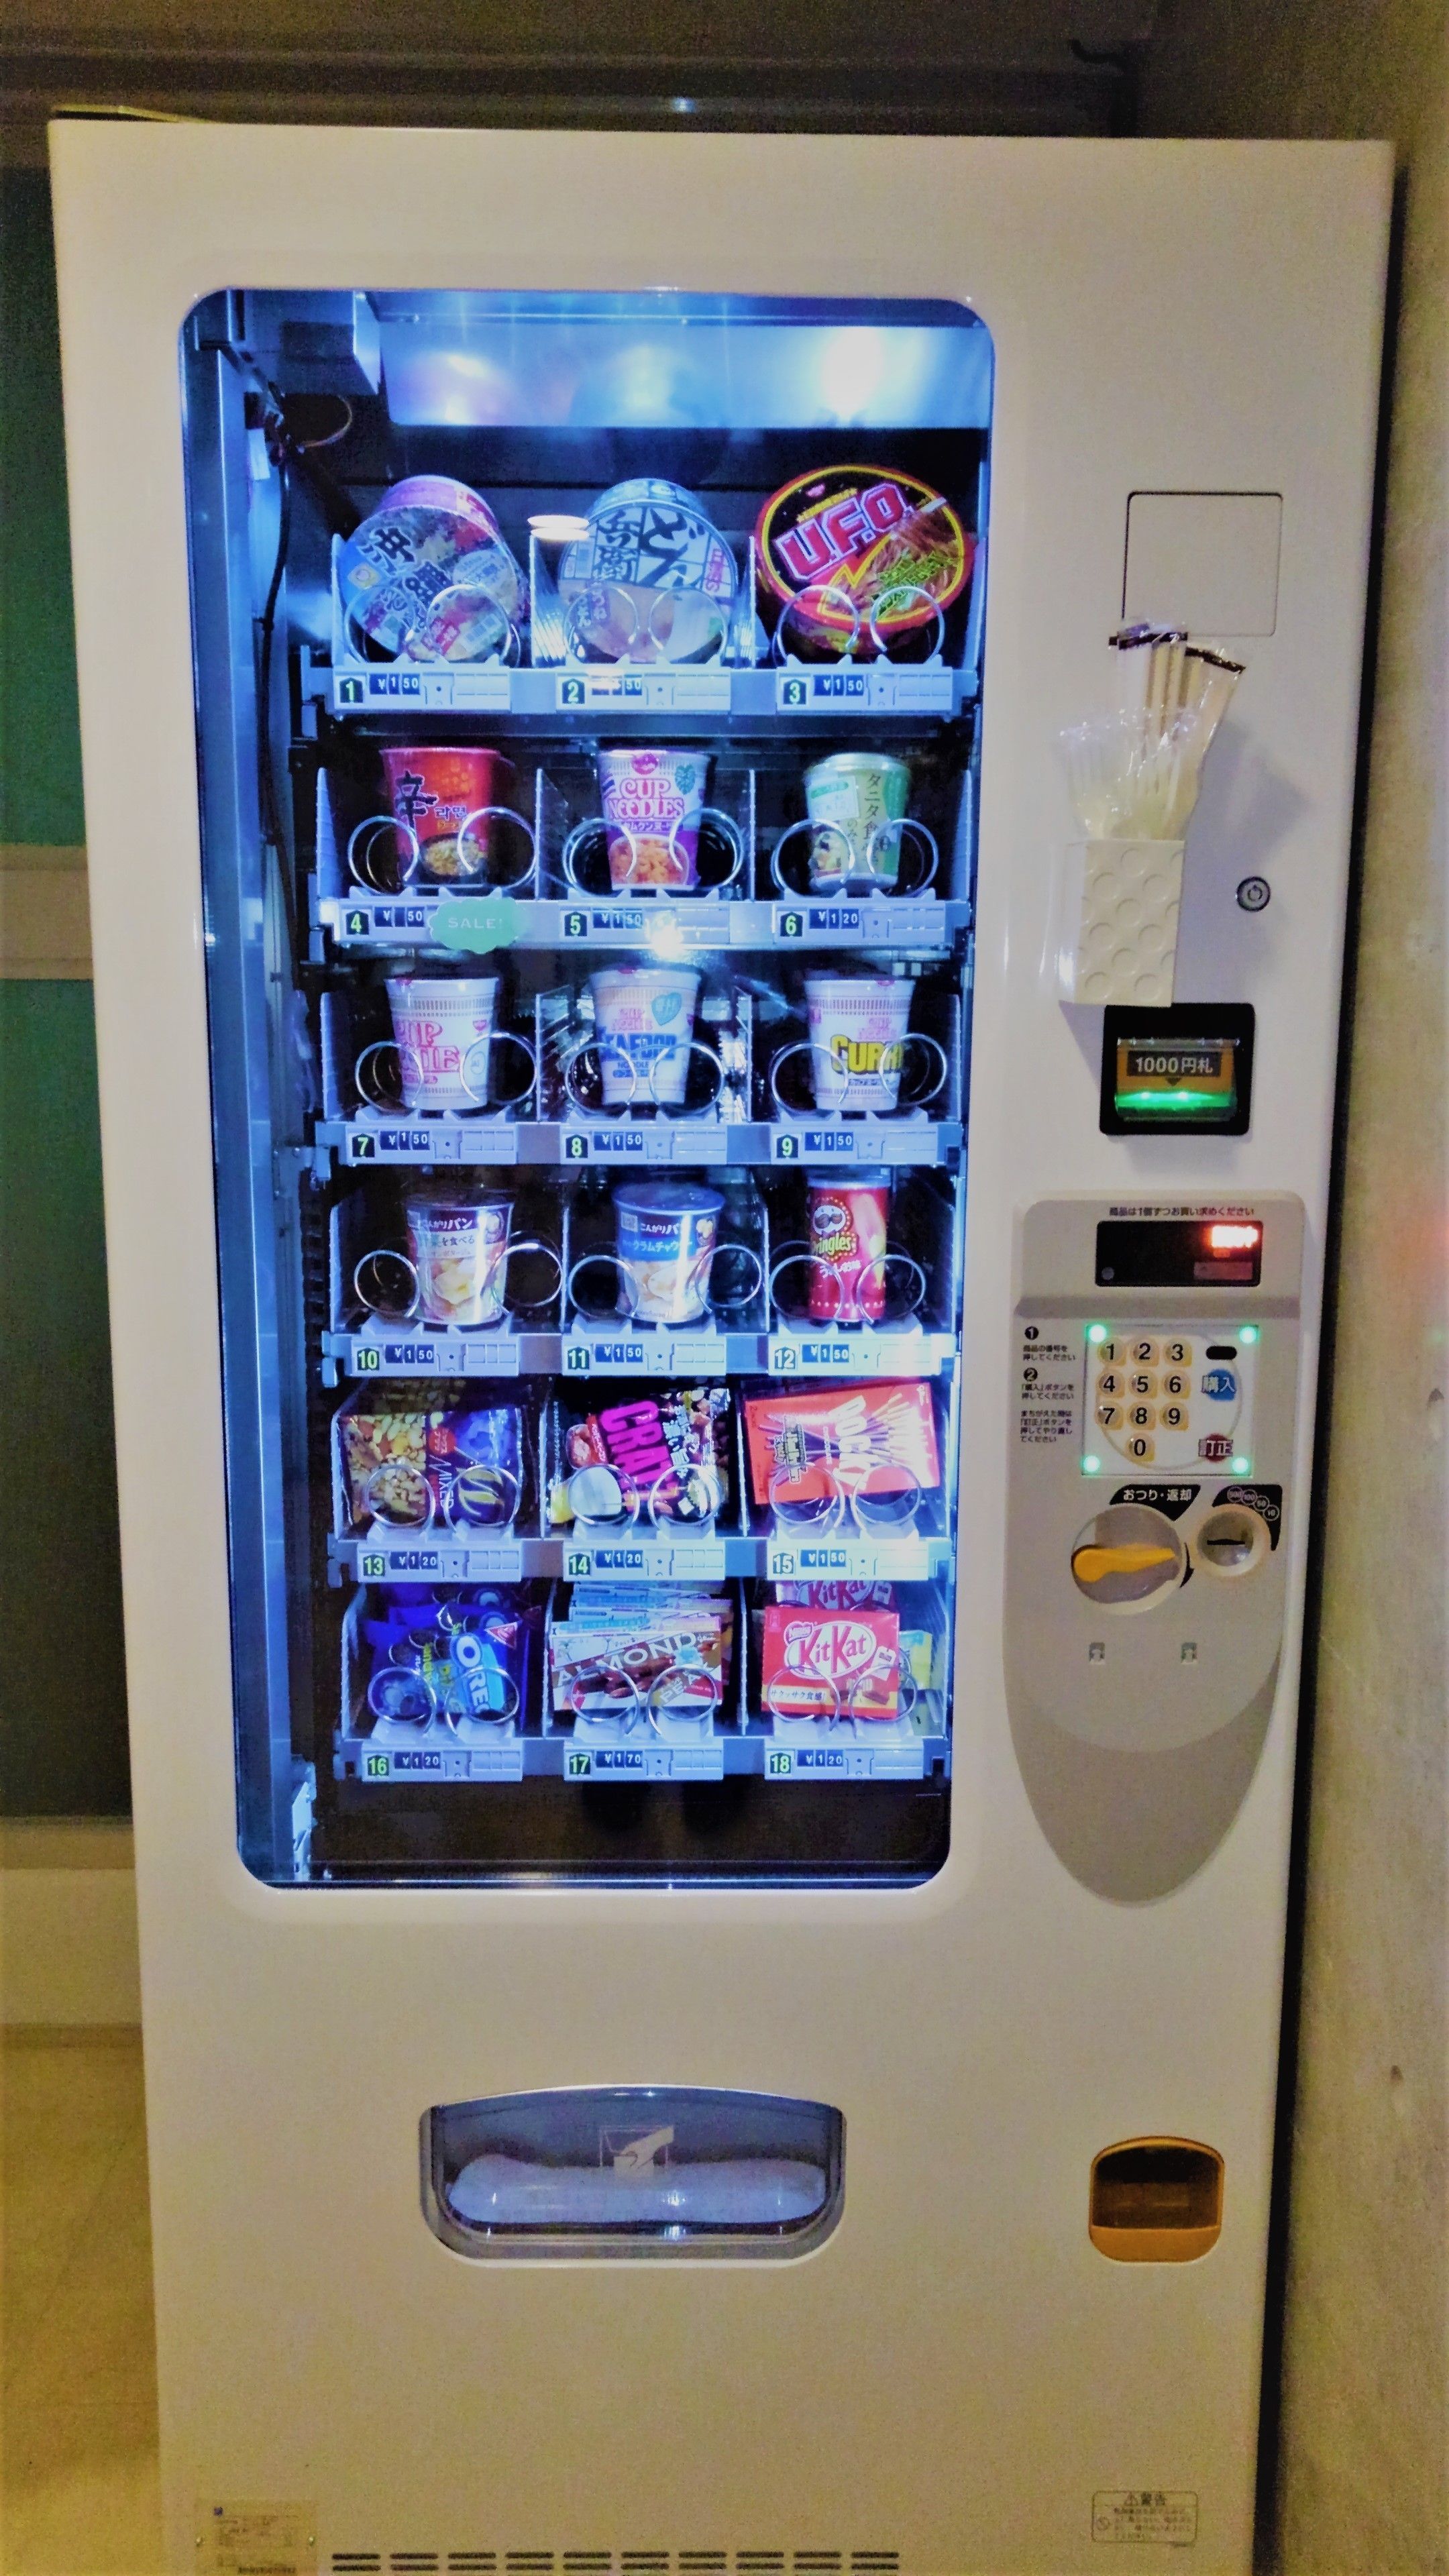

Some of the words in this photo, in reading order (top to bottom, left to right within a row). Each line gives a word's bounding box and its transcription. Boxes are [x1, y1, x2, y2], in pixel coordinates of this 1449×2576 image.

[346, 682, 354, 699] 1
[377, 678, 419, 690] ¥150
[568, 682, 579, 702] 2
[788, 682, 801, 704] 3
[824, 677, 863, 692] ¥150
[620, 778, 671, 800] CUP
[396, 771, 439, 832] 辛
[607, 798, 685, 820] NOODLES
[351, 913, 362, 933] 4
[448, 917, 502, 929] SALE!
[571, 915, 581, 934] 5
[602, 913, 642, 924] ¥150
[786, 915, 796, 934] 6
[818, 912, 858, 924] ¥120
[1136, 1057, 1213, 1073] 1000円札
[358, 1136, 368, 1155] 7
[388, 1132, 428, 1144] ¥150
[572, 1137, 582, 1156] 8
[602, 1134, 642, 1146] ¥150
[782, 1136, 792, 1155] 9
[814, 1134, 853, 1146] ¥150
[359, 1350, 378, 1369] 10
[394, 1348, 433, 1360] ¥150
[569, 1350, 586, 1368] 11
[604, 1346, 642, 1358] ¥150
[774, 1350, 795, 1369] 12
[810, 1346, 849, 1359] ¥150
[1107, 1344, 1114, 1360] 1
[1138, 1342, 1150, 1360] 2
[1171, 1344, 1183, 1361] 3
[1104, 1375, 1116, 1392] 4
[1137, 1376, 1148, 1393] 5
[1169, 1376, 1181, 1393] 6
[1103, 1408, 1115, 1424] 7
[1135, 1407, 1148, 1424] 8
[1168, 1408, 1181, 1425] 9
[1134, 1439, 1146, 1456] 0
[1124, 1489, 1191, 1501] おつり・返却
[364, 1557, 383, 1574] 13
[398, 1556, 436, 1566] ¥120
[570, 1556, 588, 1574] 14
[604, 1552, 641, 1564] ¥120
[773, 1555, 794, 1573] 15
[808, 1552, 845, 1564] ¥150
[799, 1625, 867, 1674] KitKat
[369, 1758, 387, 1774] 16
[402, 1755, 439, 1766] ¥120
[570, 1757, 589, 1774] 17
[604, 1753, 641, 1764] ¥170
[771, 1756, 790, 1773] 18
[806, 1753, 843, 1765] ¥120
